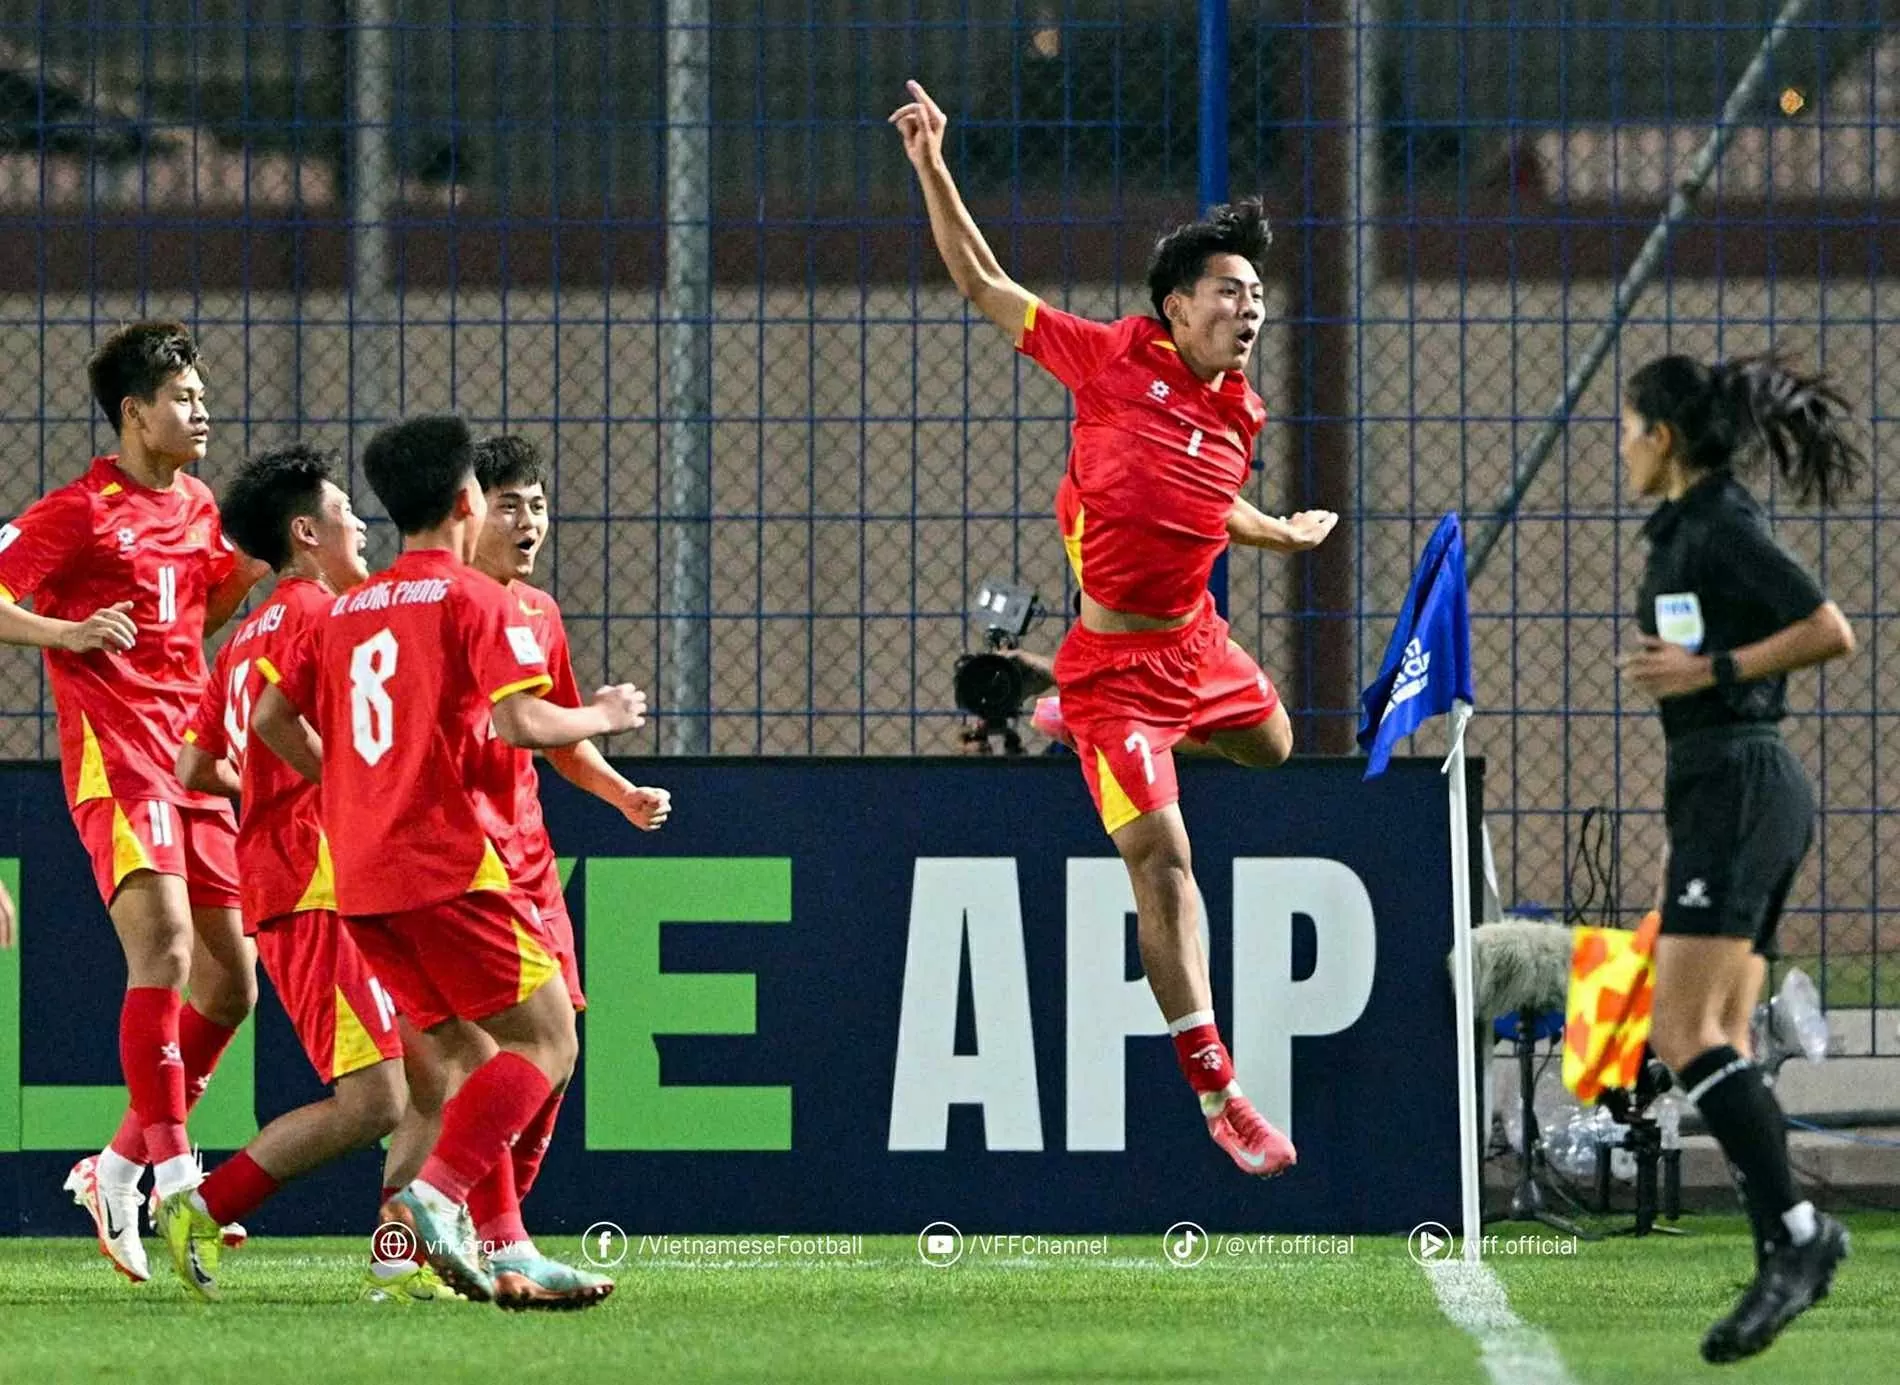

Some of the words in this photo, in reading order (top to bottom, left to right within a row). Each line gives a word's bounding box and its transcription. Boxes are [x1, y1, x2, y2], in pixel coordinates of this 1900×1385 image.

[158, 565, 177, 624] 11
[349, 626, 400, 768] 8
[1123, 730, 1156, 786] 7
[147, 799, 174, 847] 11
[0, 857, 792, 1151] LIE
[888, 857, 1377, 1151] APP
